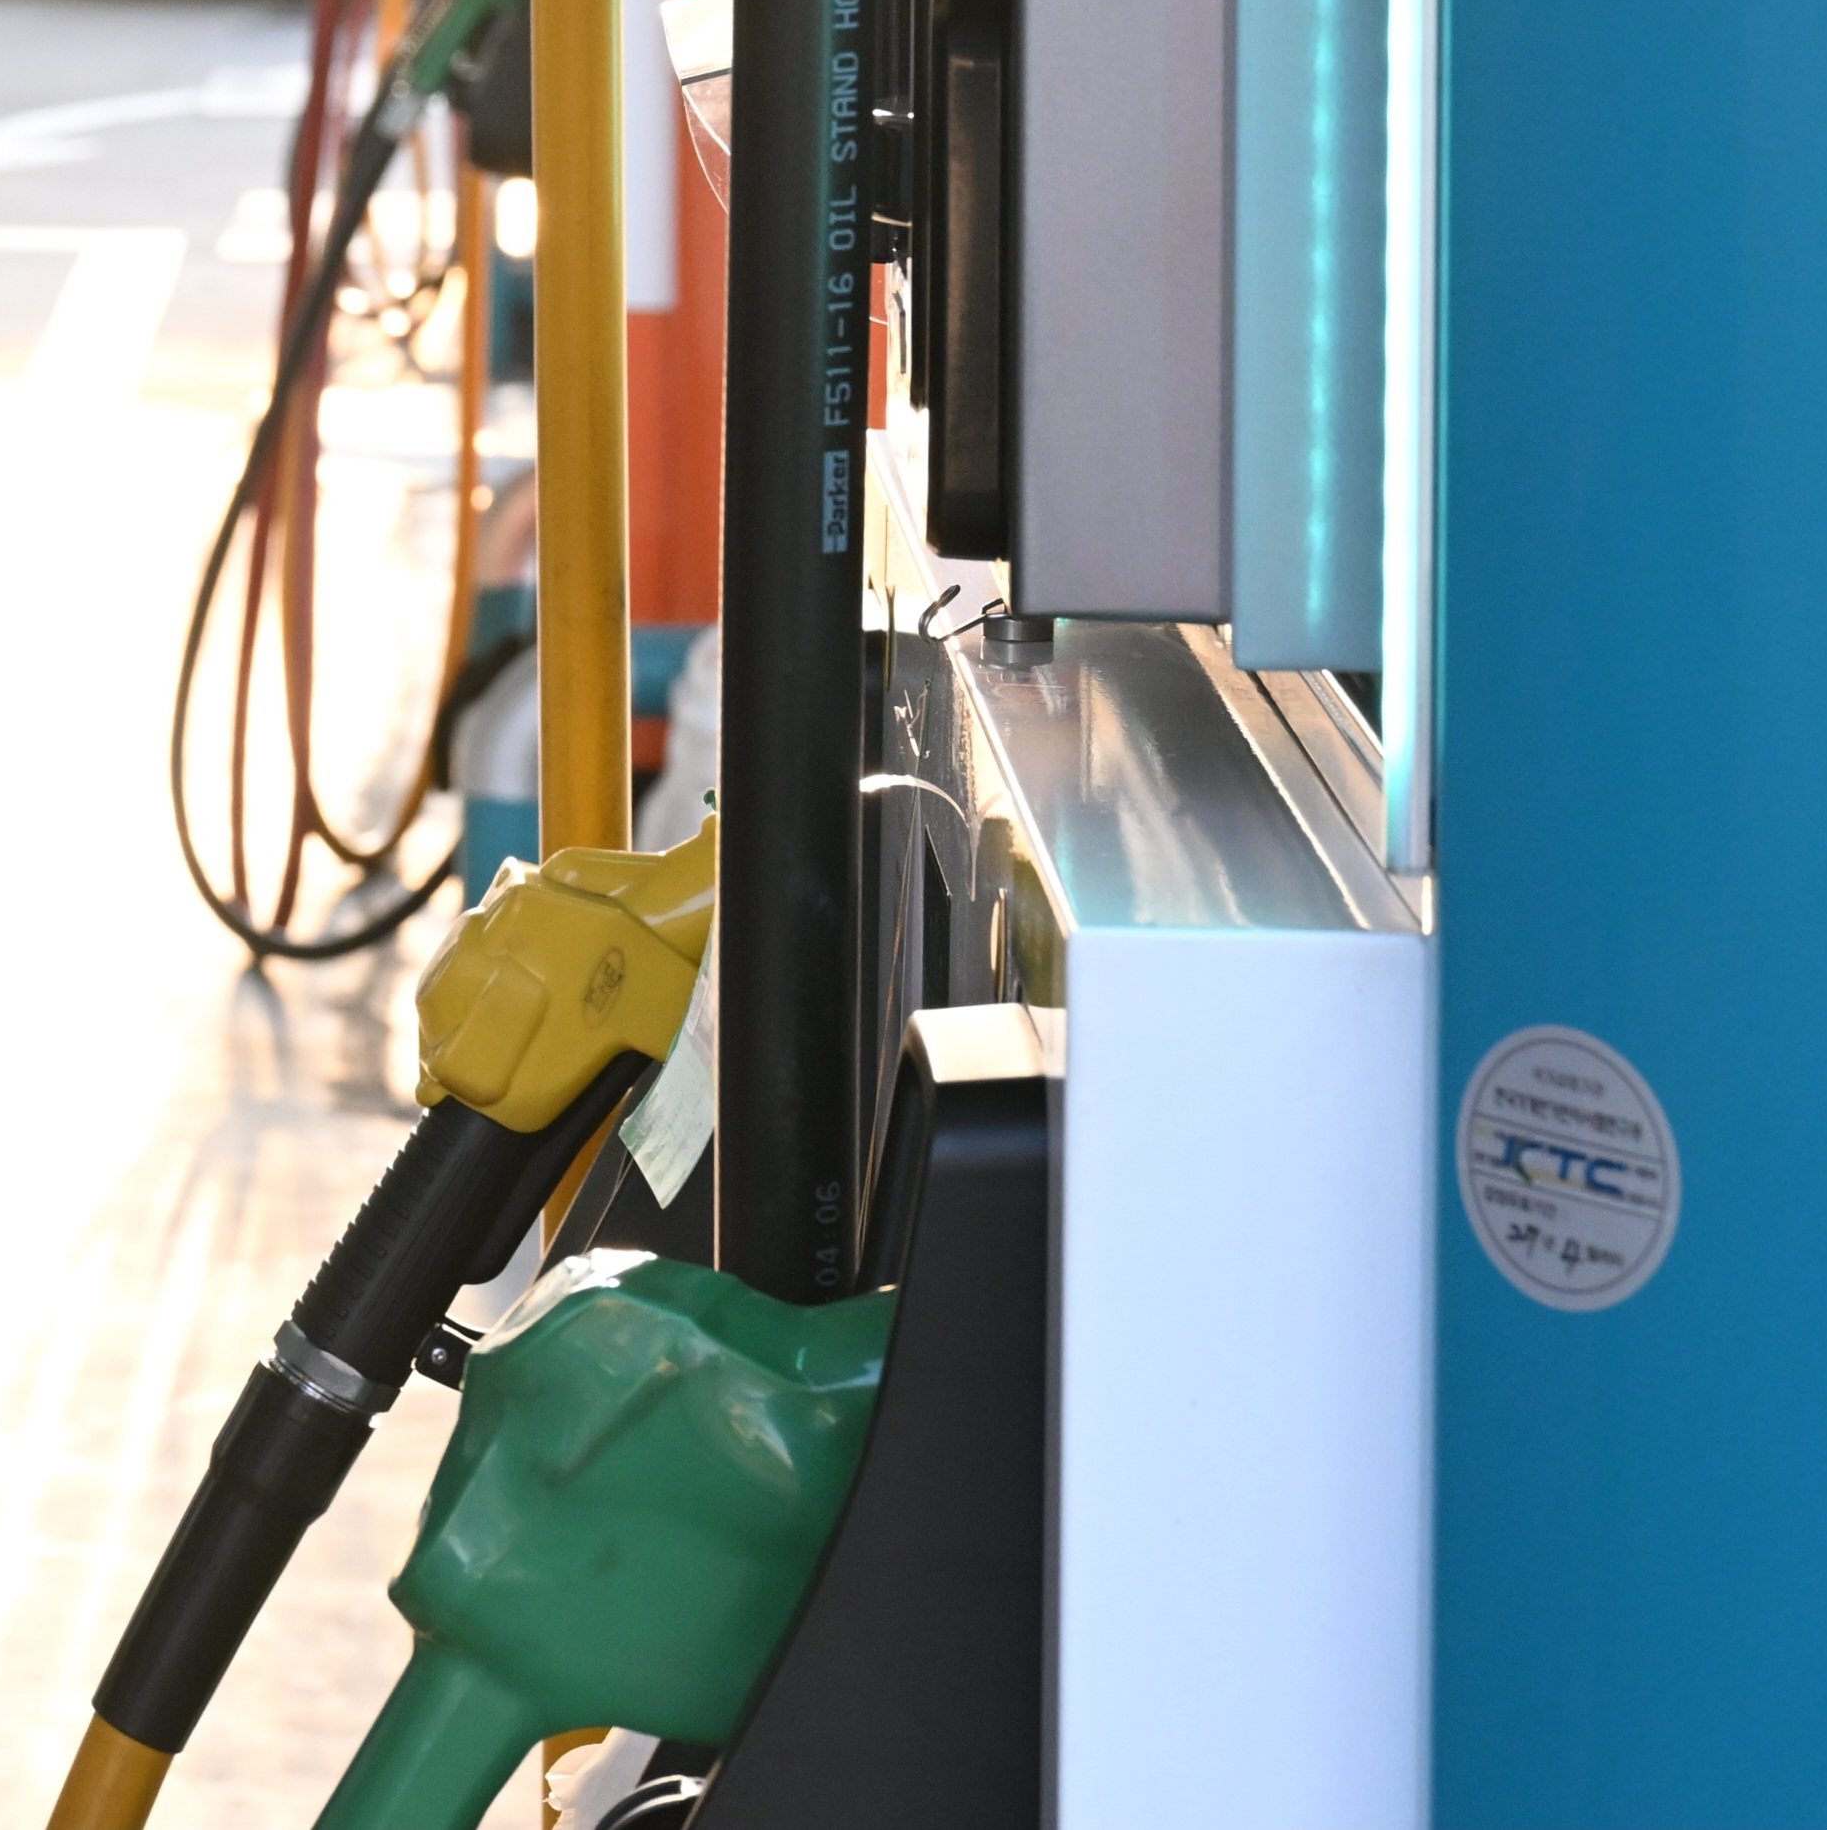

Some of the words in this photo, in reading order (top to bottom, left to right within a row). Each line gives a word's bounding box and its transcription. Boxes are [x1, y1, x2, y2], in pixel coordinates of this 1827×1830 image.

[831, 50, 859, 163] STAND
[828, 185, 857, 251] OIL
[824, 273, 855, 426] F511-16
[823, 451, 848, 544] Parker
